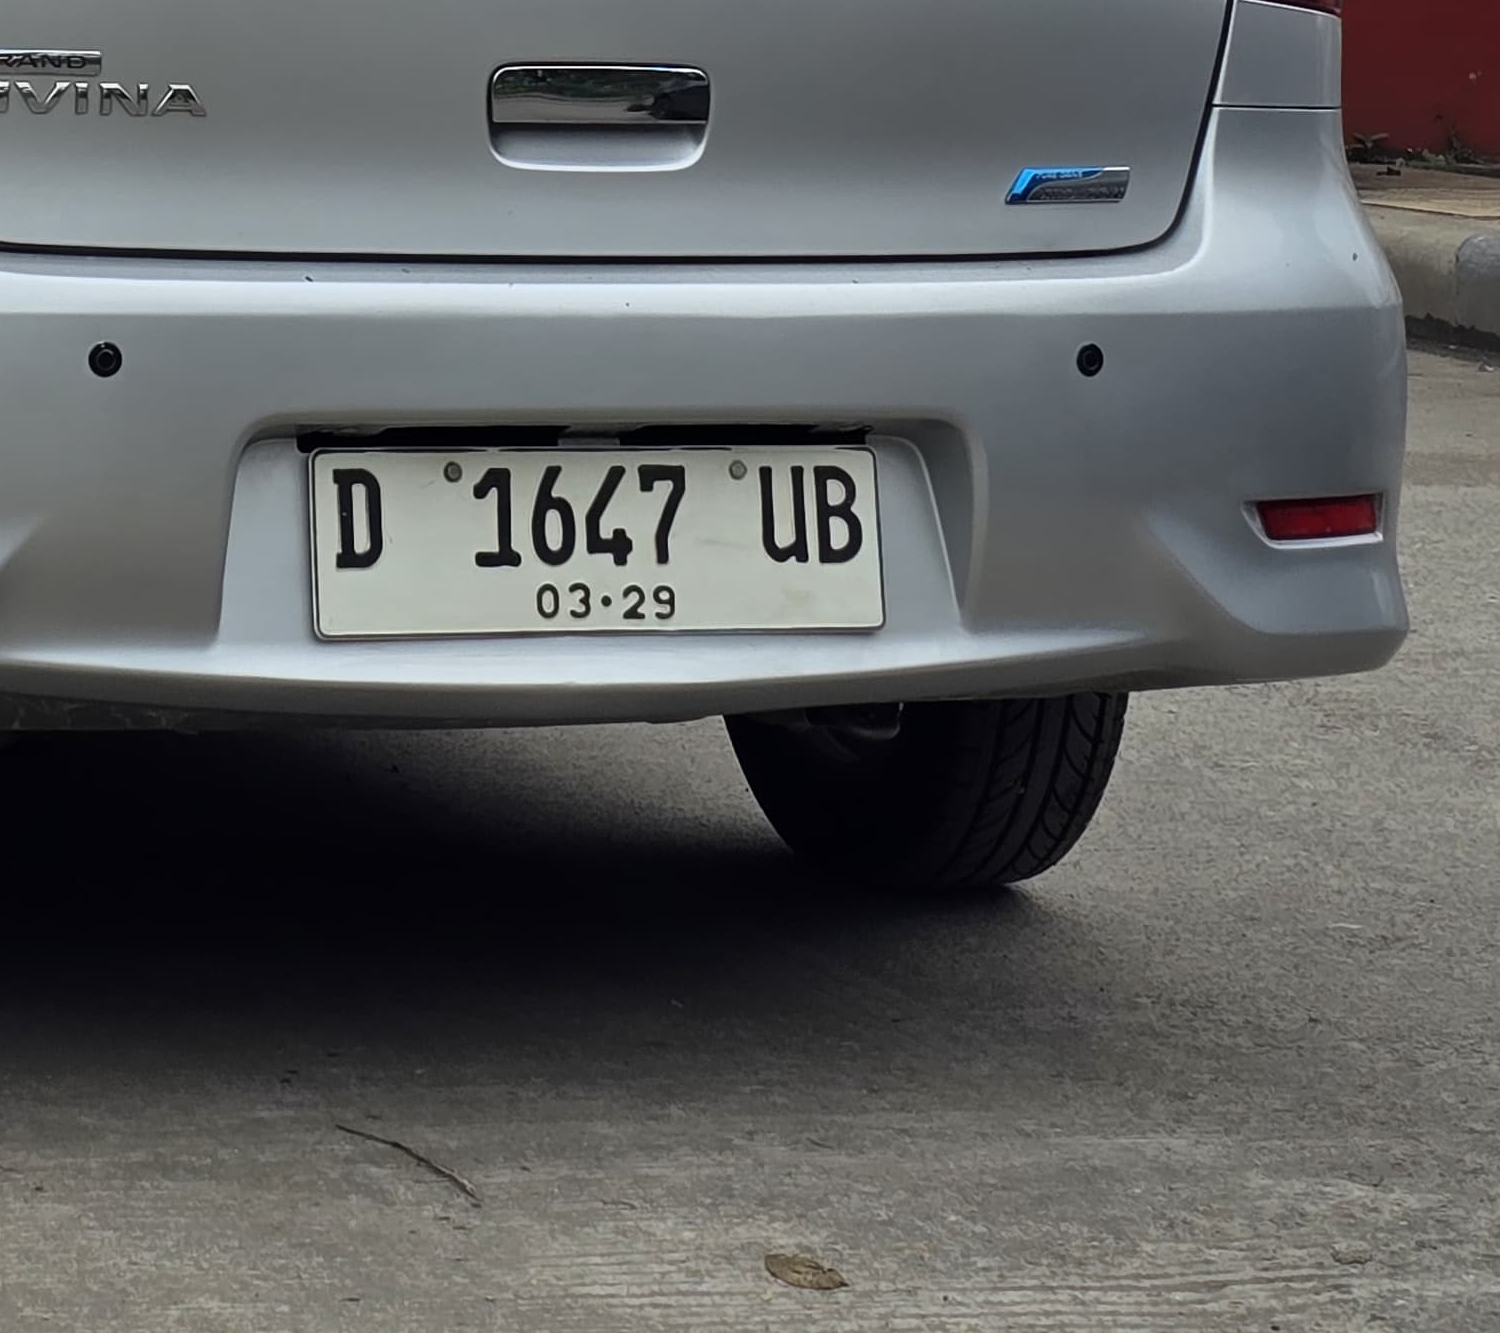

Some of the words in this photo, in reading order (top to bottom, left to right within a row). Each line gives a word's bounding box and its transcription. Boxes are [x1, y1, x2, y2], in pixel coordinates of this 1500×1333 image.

[332, 467, 384, 569] D
[472, 464, 686, 567] 1647
[759, 465, 864, 564] UB
